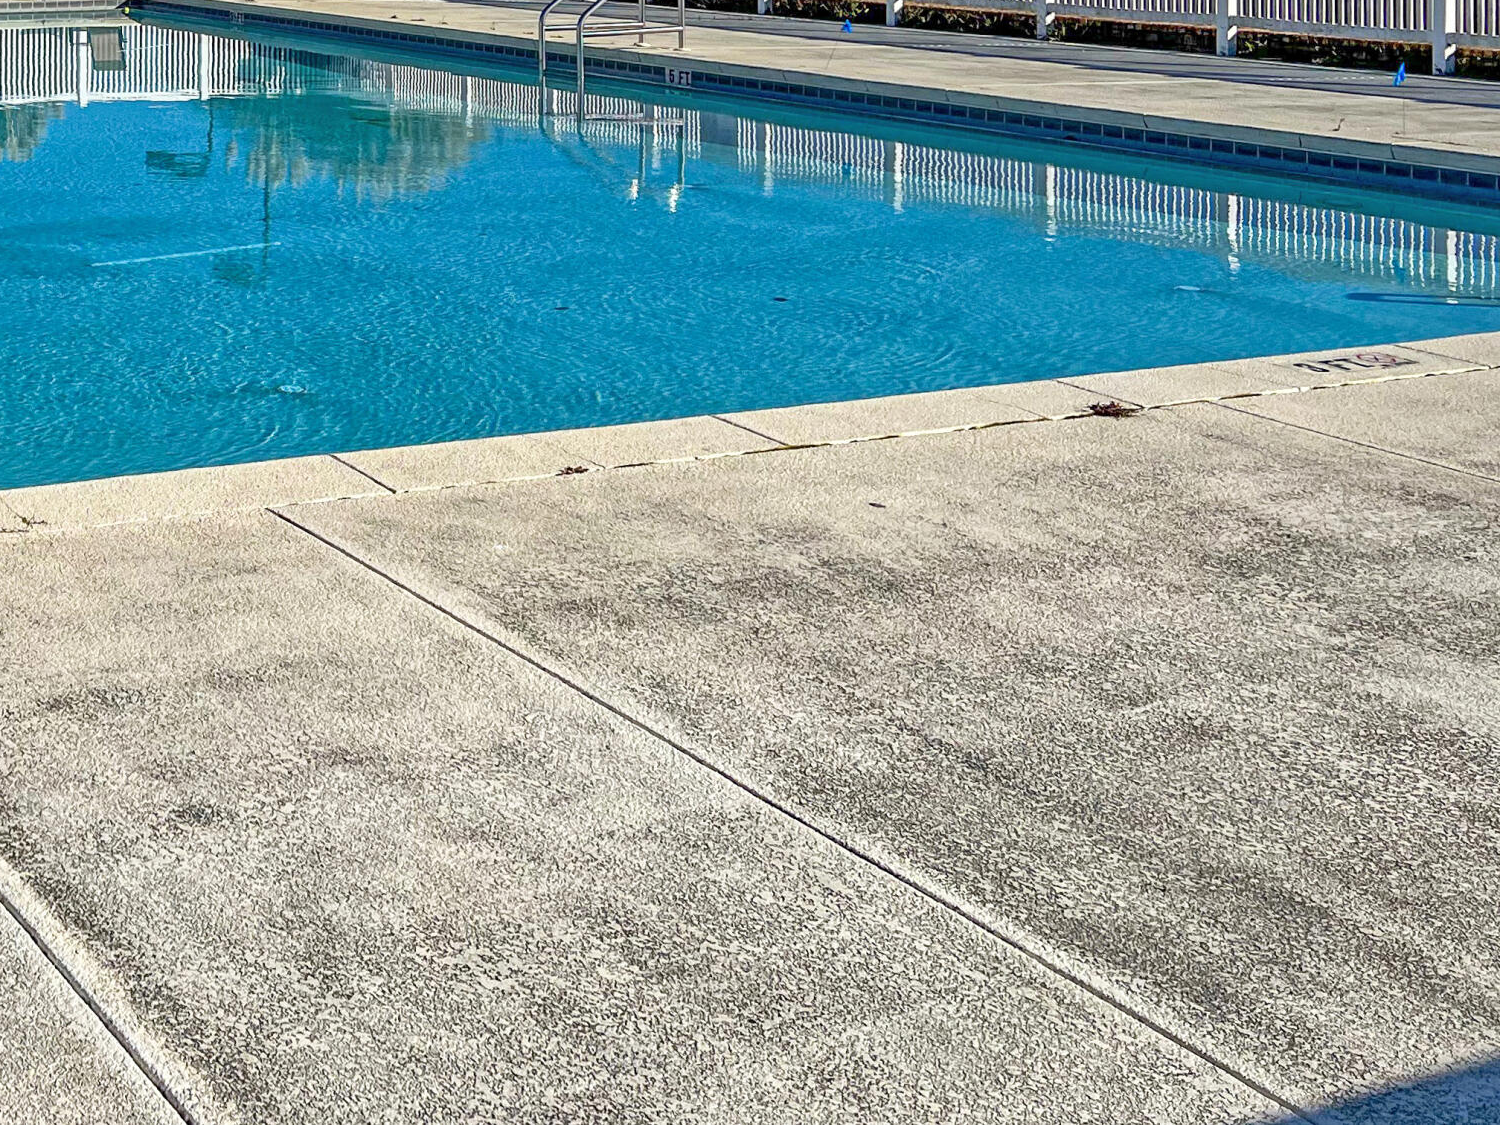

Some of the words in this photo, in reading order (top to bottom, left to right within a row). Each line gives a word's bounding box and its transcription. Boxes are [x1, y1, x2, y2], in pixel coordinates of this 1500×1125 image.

[669, 69, 675, 83] 5
[679, 70, 690, 85] FT
[1317, 358, 1375, 371] FT
